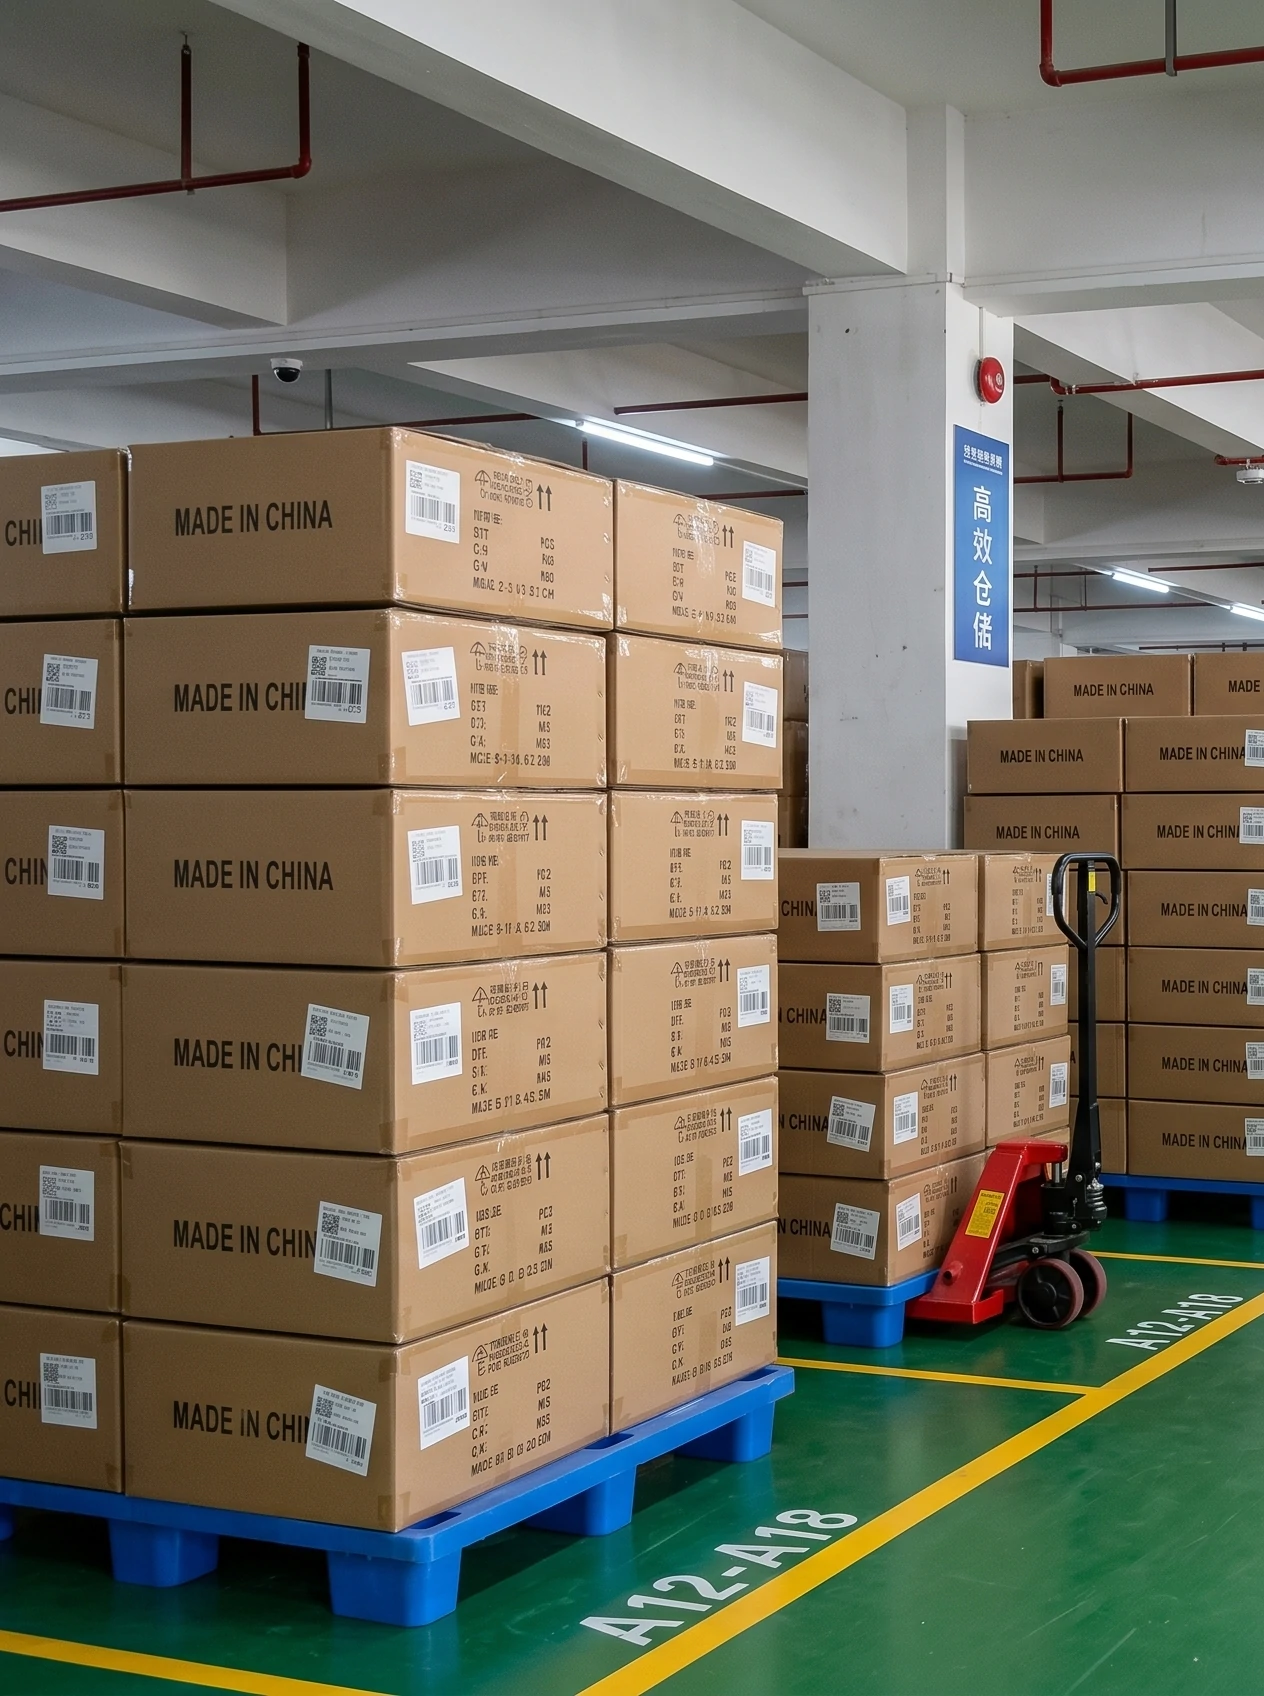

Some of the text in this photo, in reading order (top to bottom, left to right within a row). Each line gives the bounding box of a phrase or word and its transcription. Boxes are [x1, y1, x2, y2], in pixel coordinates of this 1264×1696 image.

[175, 500, 333, 537] MADE IN CHINA
[5, 519, 43, 547] CHI
[973, 485, 993, 651] 高效仓储
[1073, 682, 1155, 697] MADE IN CHINA
[1228, 679, 1261, 693] MADE
[5, 687, 42, 715] CHI
[174, 681, 306, 713] MADE IN CHI
[1000, 748, 1084, 764] MADE IN CHINA
[1159, 746, 1193, 761] MADE
[1195, 746, 1208, 761] IN
[996, 825, 1080, 840] MADE IN CHINA
[1157, 824, 1190, 839] MADE
[1192, 824, 1205, 839] IN
[174, 859, 334, 891] MADE IN CHINA
[780, 899, 817, 917] CHIN
[1160, 902, 1248, 918] MADE IN CHINA
[1161, 979, 1248, 995] MADE IN CHINA
[173, 1037, 234, 1070] MADE
[240, 1041, 260, 1071] IN
[1161, 1056, 1248, 1074] MADE IN CHINA
[788, 1113, 829, 1132] CHINA
[1162, 1132, 1196, 1148] MADE
[1198, 1134, 1210, 1149] IN
[173, 1219, 316, 1259] MADE IN CHIN
[789, 1218, 831, 1239] CHINA
[1104, 1293, 1244, 1351] A12-A18
[4, 1378, 42, 1410] CHI
[173, 1400, 233, 1435] MADE
[579, 1509, 858, 1647] A12-A18
